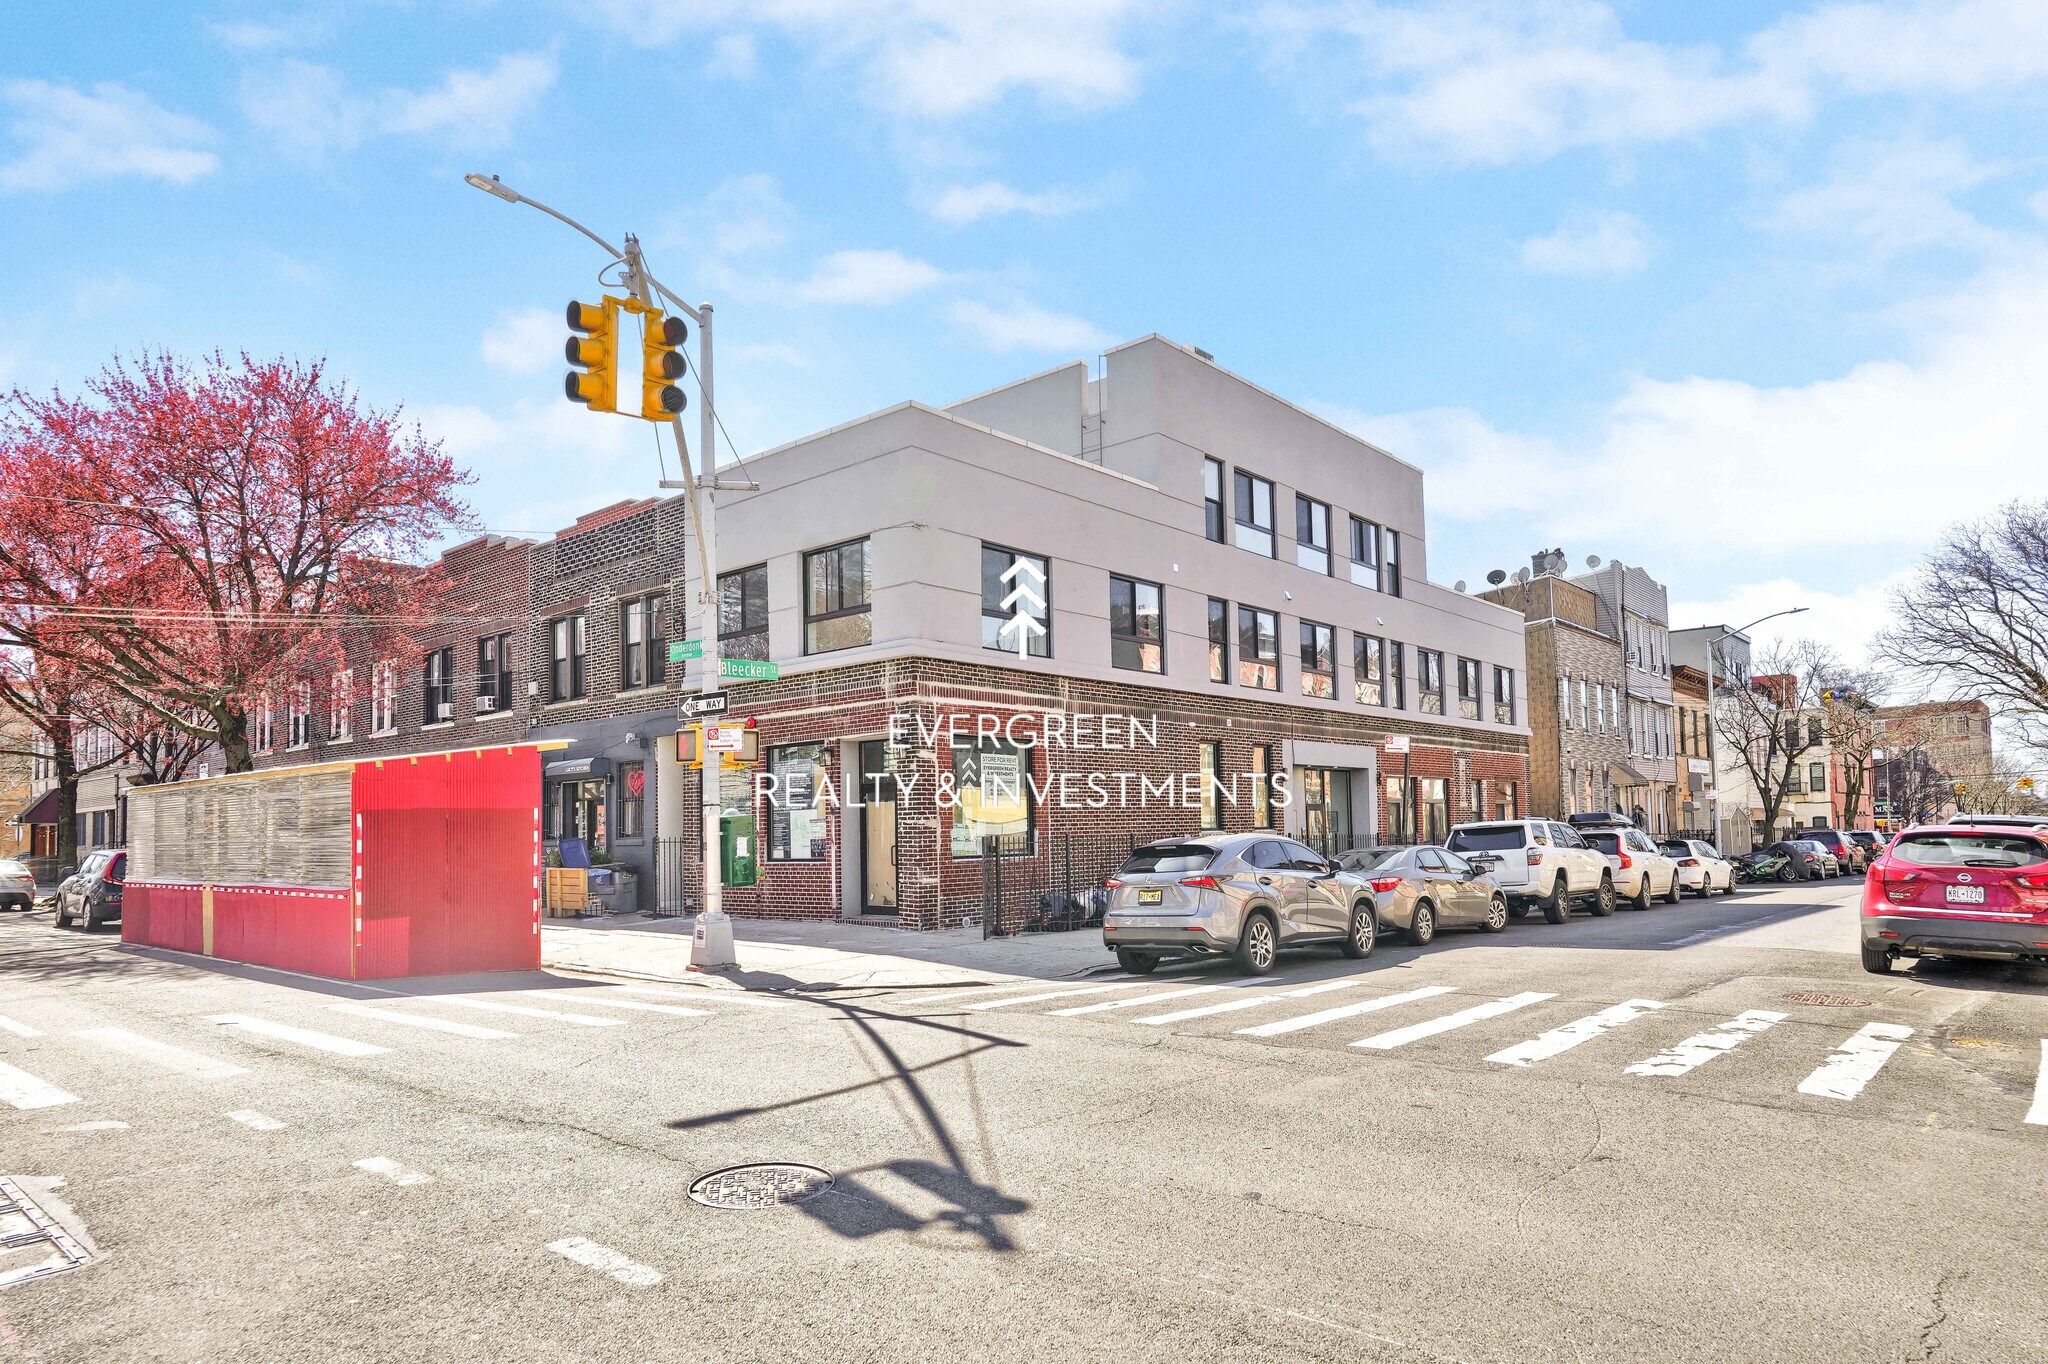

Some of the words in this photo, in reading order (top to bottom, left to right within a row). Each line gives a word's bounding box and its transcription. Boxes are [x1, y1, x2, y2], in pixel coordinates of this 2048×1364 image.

[721, 661, 767, 677] Bleecker
[770, 665, 777, 674] St
[685, 701, 700, 712] ONE
[706, 699, 721, 710] WAY
